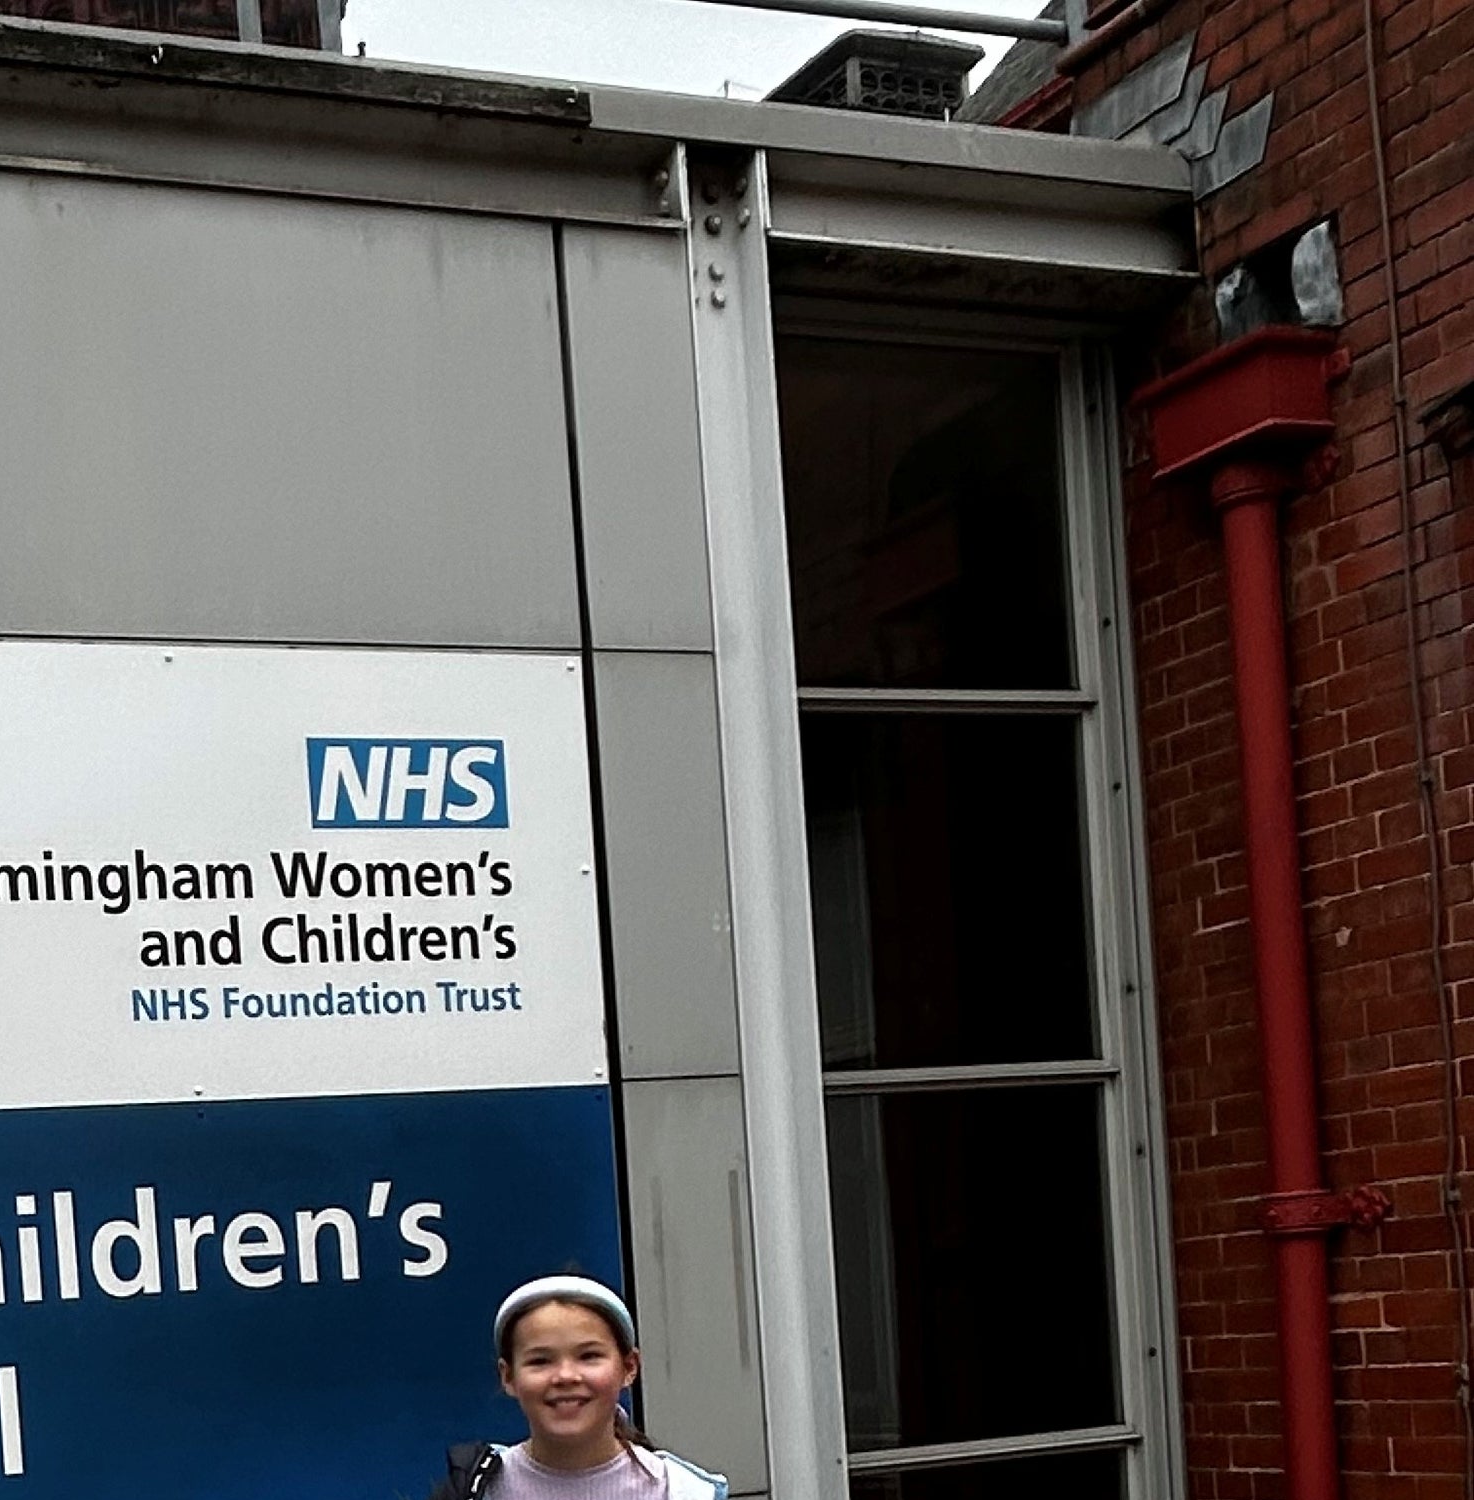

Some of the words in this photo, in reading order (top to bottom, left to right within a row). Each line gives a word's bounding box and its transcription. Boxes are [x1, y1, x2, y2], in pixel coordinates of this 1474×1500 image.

[315, 744, 498, 822] NHS
[269, 850, 513, 900] Women's
[139, 913, 242, 968] and
[261, 913, 517, 966] Children's
[131, 987, 210, 1022] NHS
[222, 981, 427, 1020] Foundation
[435, 980, 523, 1013] Trust
